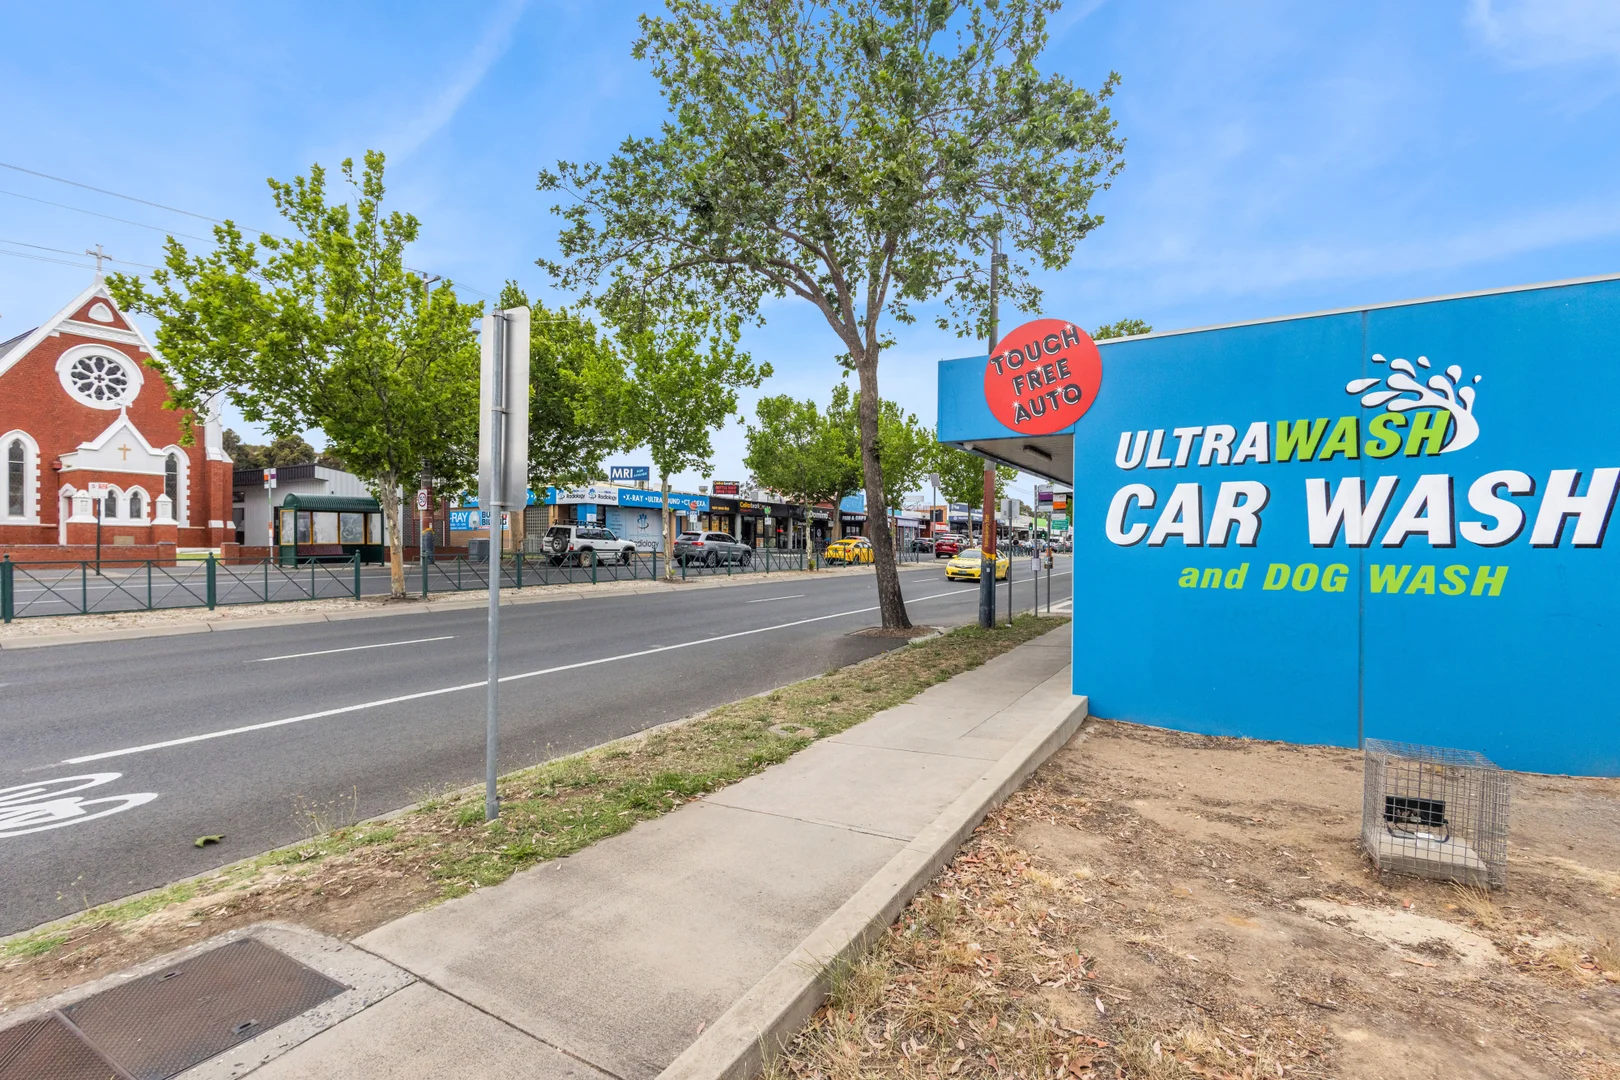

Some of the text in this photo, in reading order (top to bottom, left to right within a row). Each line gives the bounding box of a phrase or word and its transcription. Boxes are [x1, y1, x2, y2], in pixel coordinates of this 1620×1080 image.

[990, 324, 1080, 375] TOUCH
[1012, 358, 1071, 396] FREE
[1014, 383, 1082, 425] AUTO
[611, 468, 634, 479] MRI
[450, 511, 468, 523] -RAY
[625, 494, 644, 502] X-RAY
[647, 495, 680, 505] ULTRAUND
[1105, 466, 1620, 549] CAR WASH
[1178, 563, 1509, 596] and DOG WASH
